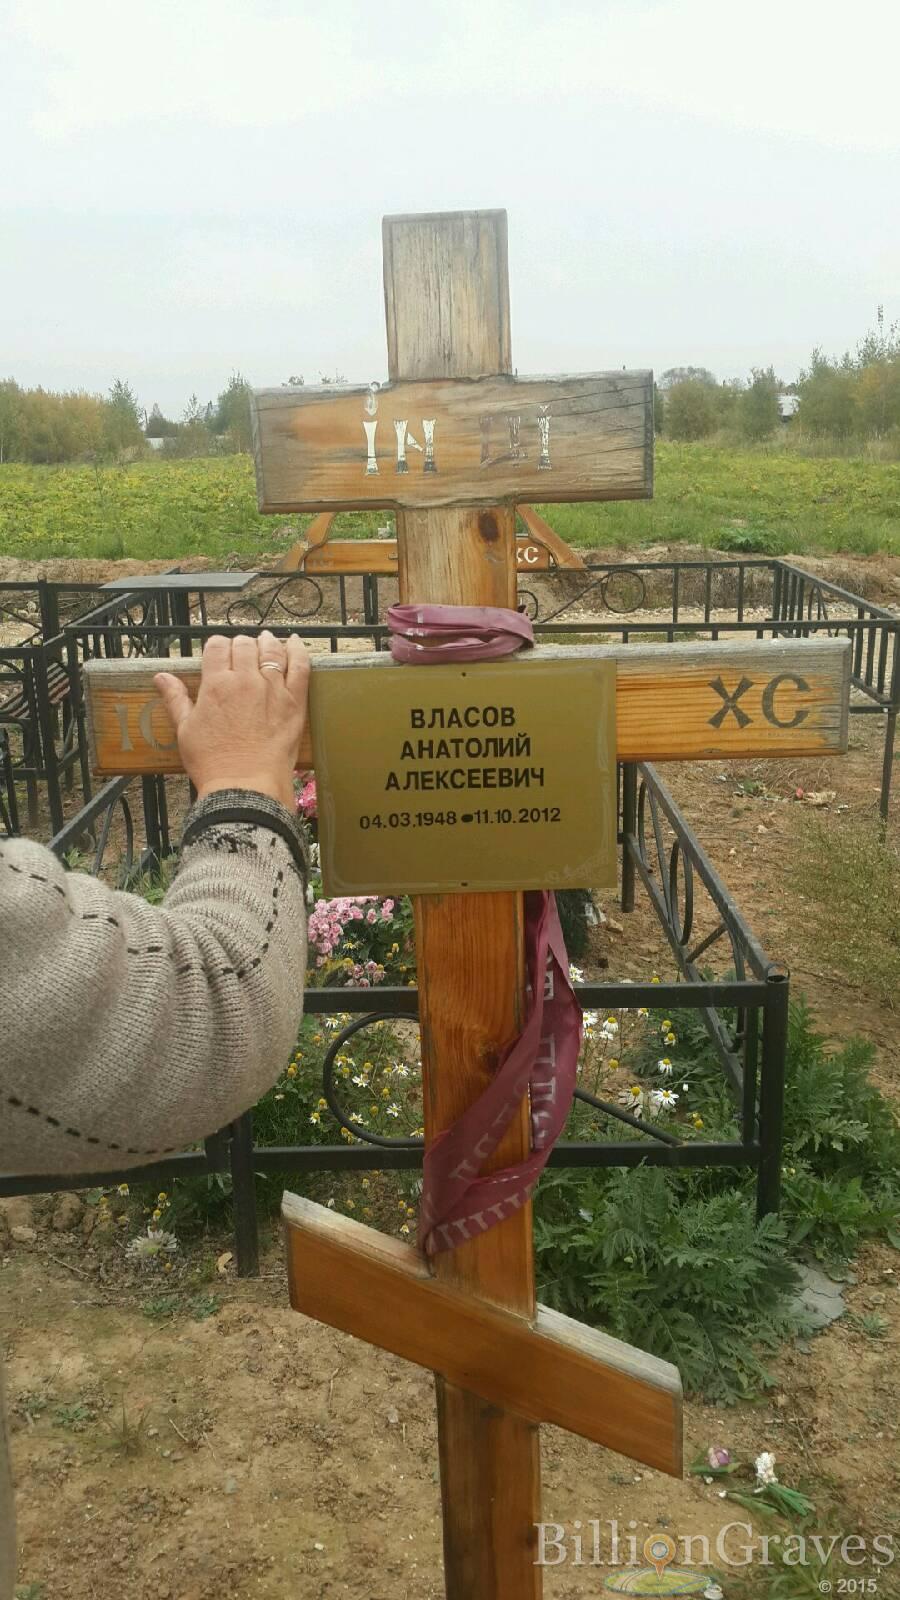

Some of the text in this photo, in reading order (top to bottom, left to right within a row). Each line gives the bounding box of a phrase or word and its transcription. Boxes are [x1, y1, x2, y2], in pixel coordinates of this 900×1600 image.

[410, 705, 516, 729] ВЛАСОВ
[399, 732, 532, 761] АНАТОЛИЙ
[384, 767, 545, 792] АЛЕКСЕЕВИЧ
